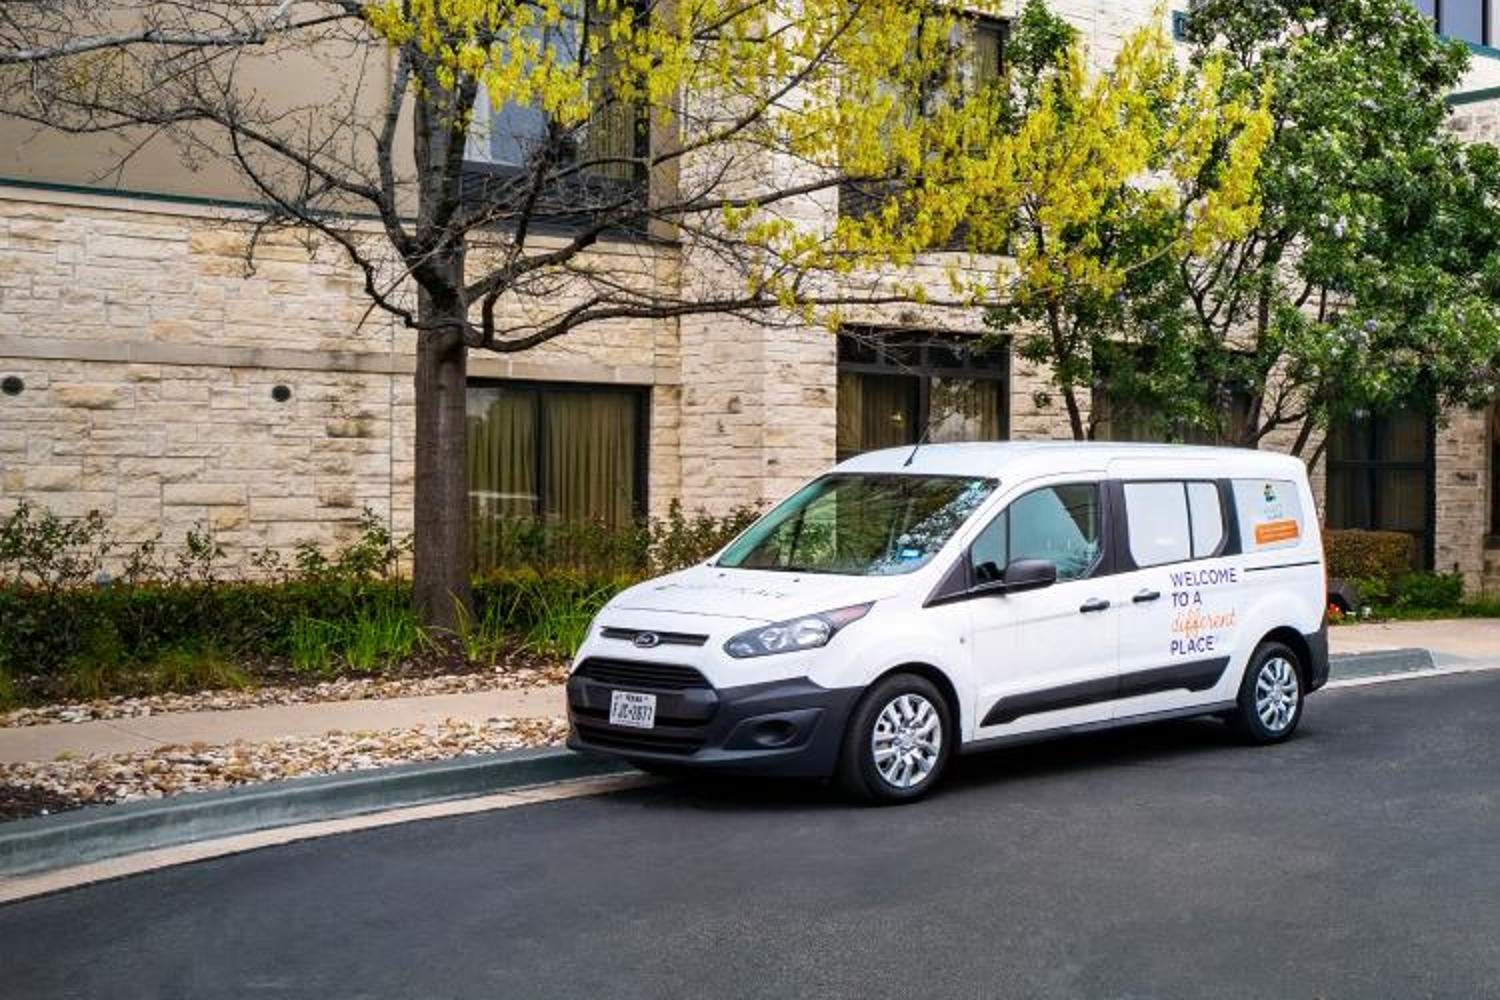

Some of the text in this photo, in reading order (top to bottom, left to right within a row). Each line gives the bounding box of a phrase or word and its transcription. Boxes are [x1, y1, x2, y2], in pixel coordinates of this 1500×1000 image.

[1170, 567, 1238, 588] WELCOME
[1171, 591, 1203, 608] TO A
[1171, 606, 1236, 638] different
[1170, 635, 1215, 656] PLACE
